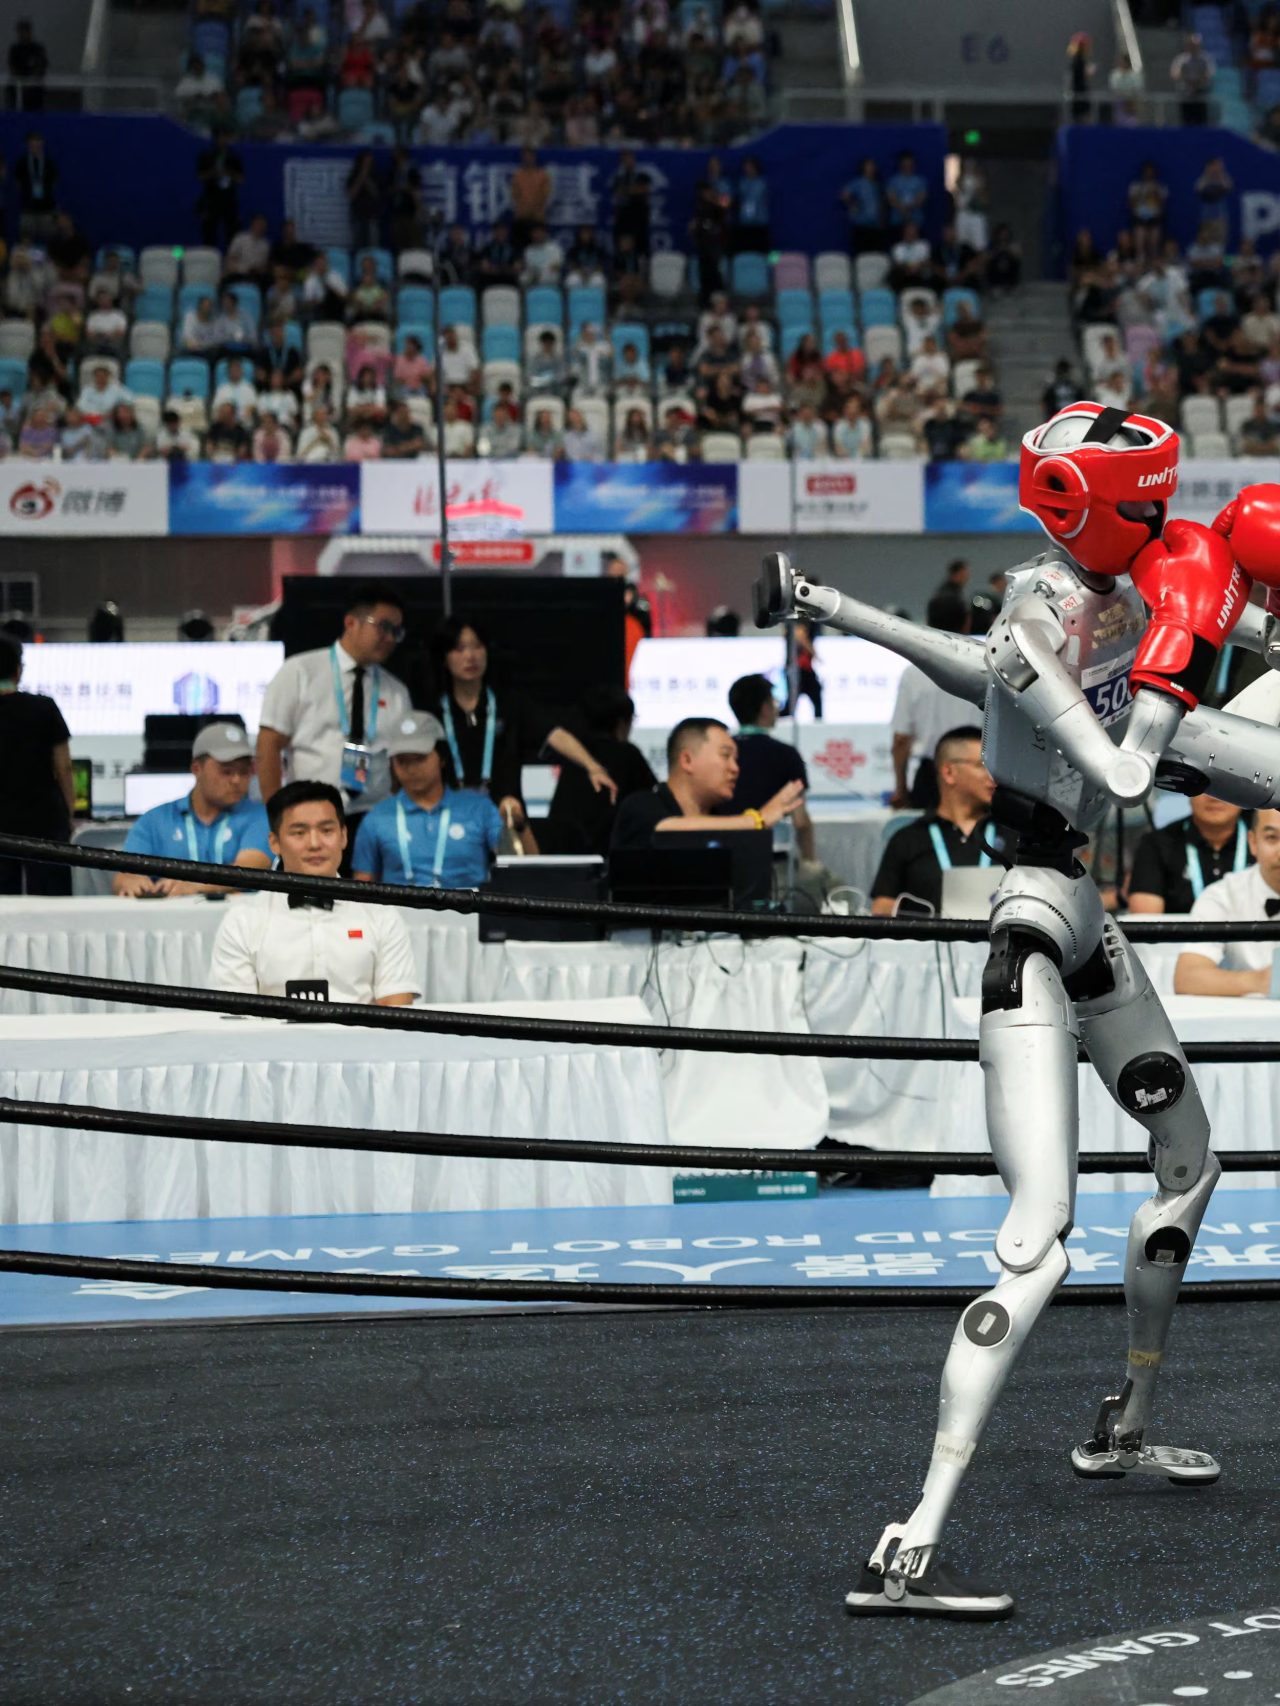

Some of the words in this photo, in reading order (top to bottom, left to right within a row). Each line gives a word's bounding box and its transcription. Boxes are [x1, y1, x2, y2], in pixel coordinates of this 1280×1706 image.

[1138, 466, 1178, 488] UNIT
[1095, 676, 1134, 718] 50
[490, 1233, 821, 1255] ROBOT
[995, 1631, 1200, 1688] GAMES
